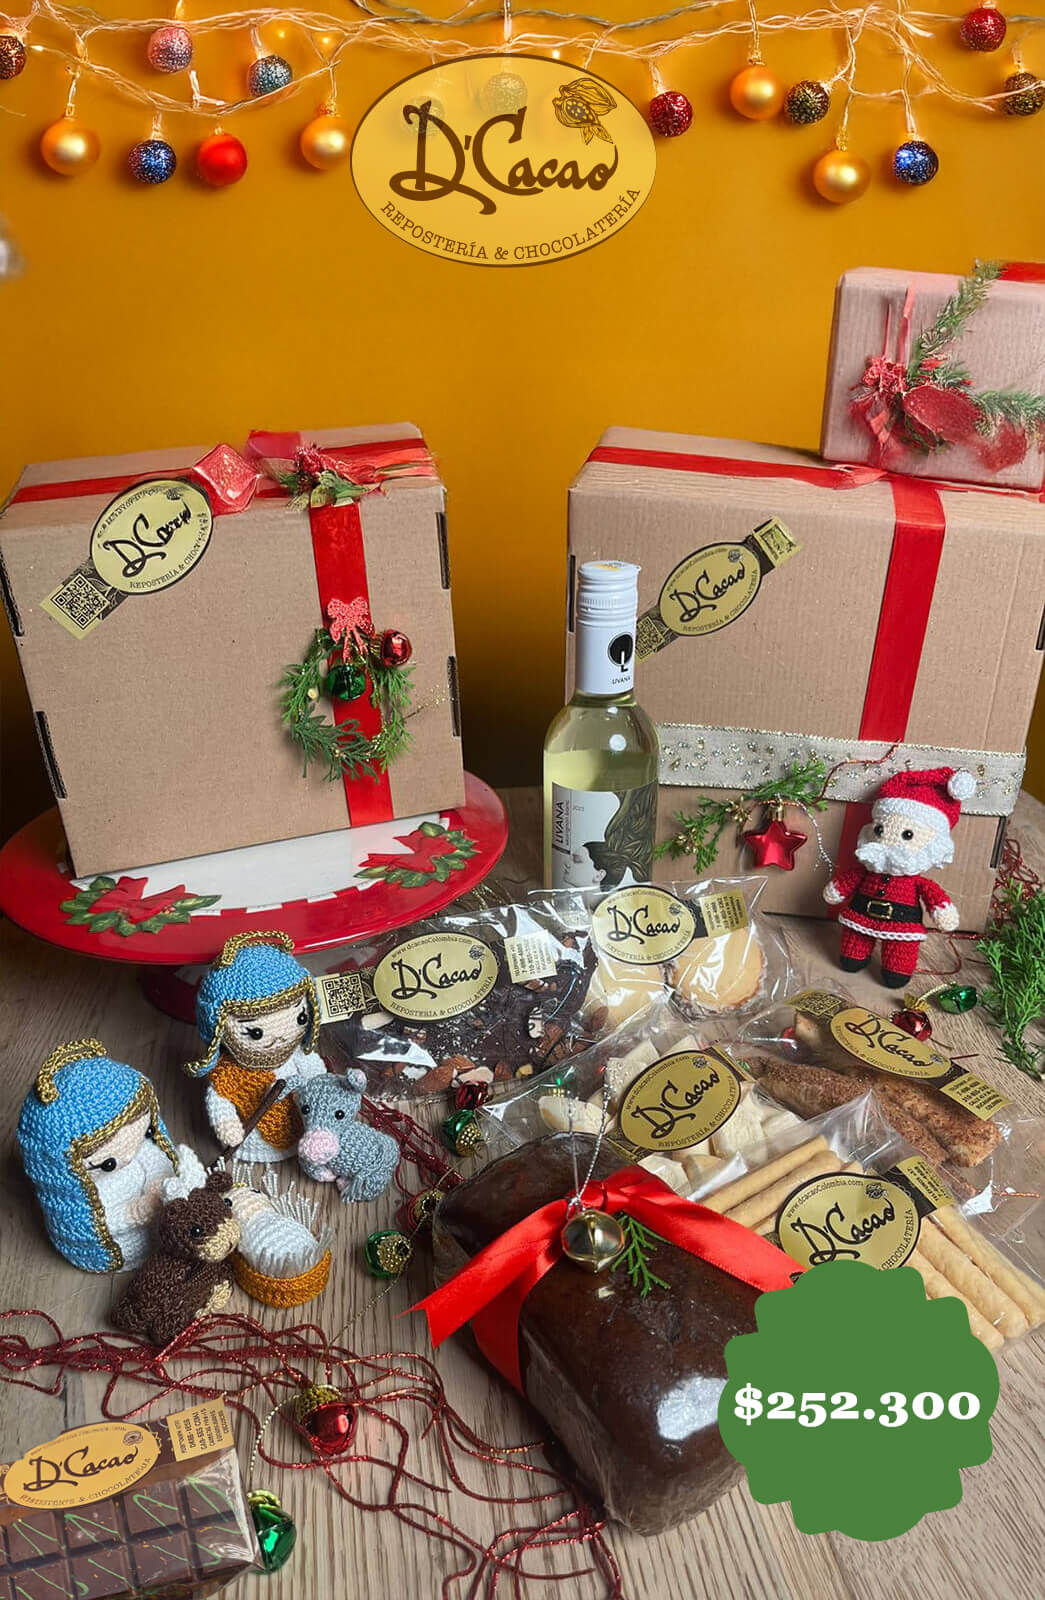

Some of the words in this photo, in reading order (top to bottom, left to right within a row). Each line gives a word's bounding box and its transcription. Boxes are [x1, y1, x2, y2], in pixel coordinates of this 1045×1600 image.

[668, 561, 746, 622] D'Cacao
[555, 801, 564, 844] LIVANA
[606, 905, 681, 945] D'Cacao
[391, 952, 483, 1000] D'Cacao
[439, 1008, 447, 1016] &
[844, 1014, 935, 1067] D'Cacao
[630, 1066, 721, 1139] D'Cacao
[786, 1178, 865, 1219] www.dcacaoColombia.com
[790, 1197, 896, 1266] D'Cacao
[881, 1208, 914, 1271] CHOCOLATERÍA
[23, 1446, 139, 1492] D'Cacao
